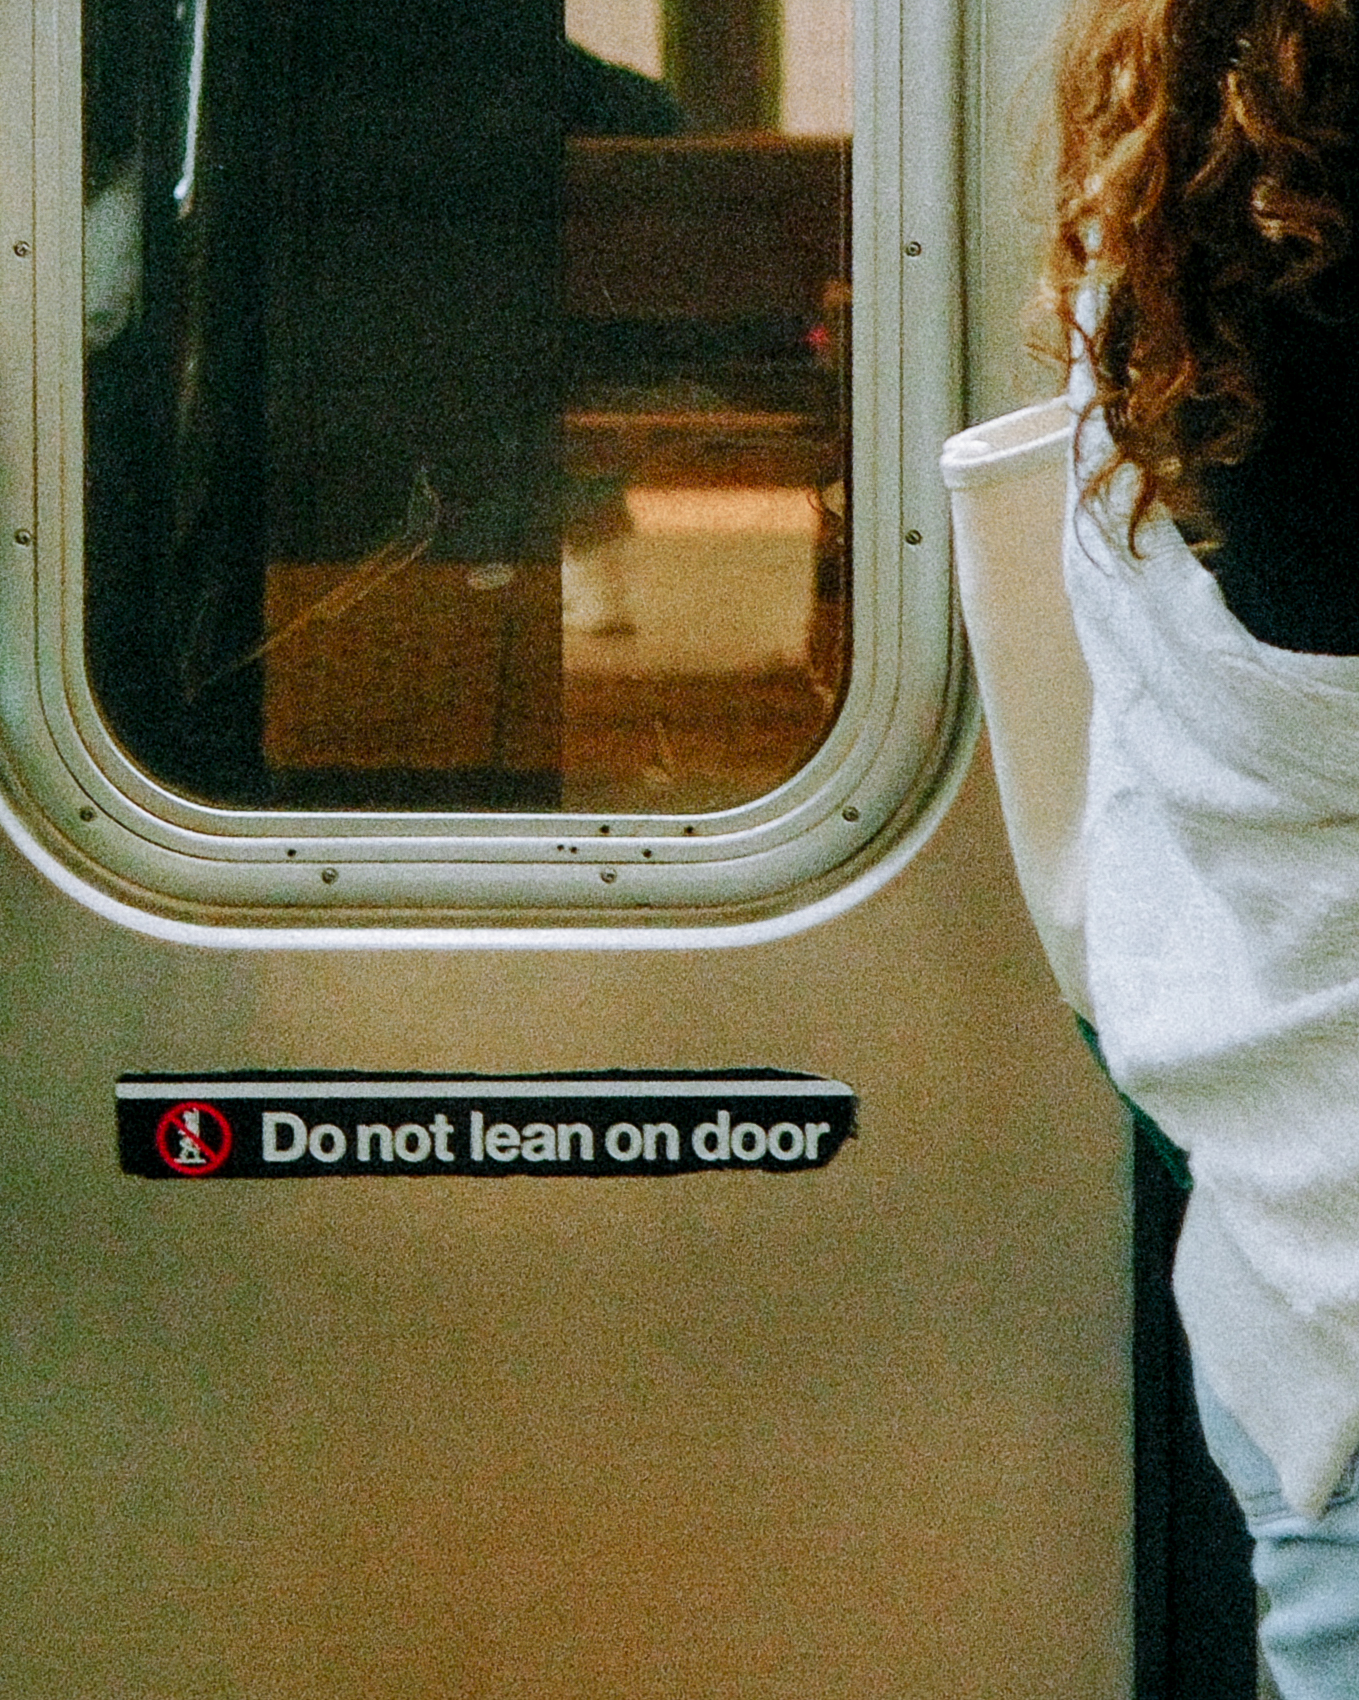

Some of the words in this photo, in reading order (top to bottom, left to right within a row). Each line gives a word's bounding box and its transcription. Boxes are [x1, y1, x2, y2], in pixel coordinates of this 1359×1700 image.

[261, 1111, 347, 1164] Do
[356, 1112, 454, 1163] not
[470, 1110, 594, 1163] lean
[603, 1122, 680, 1163] on
[691, 1110, 831, 1163] door
